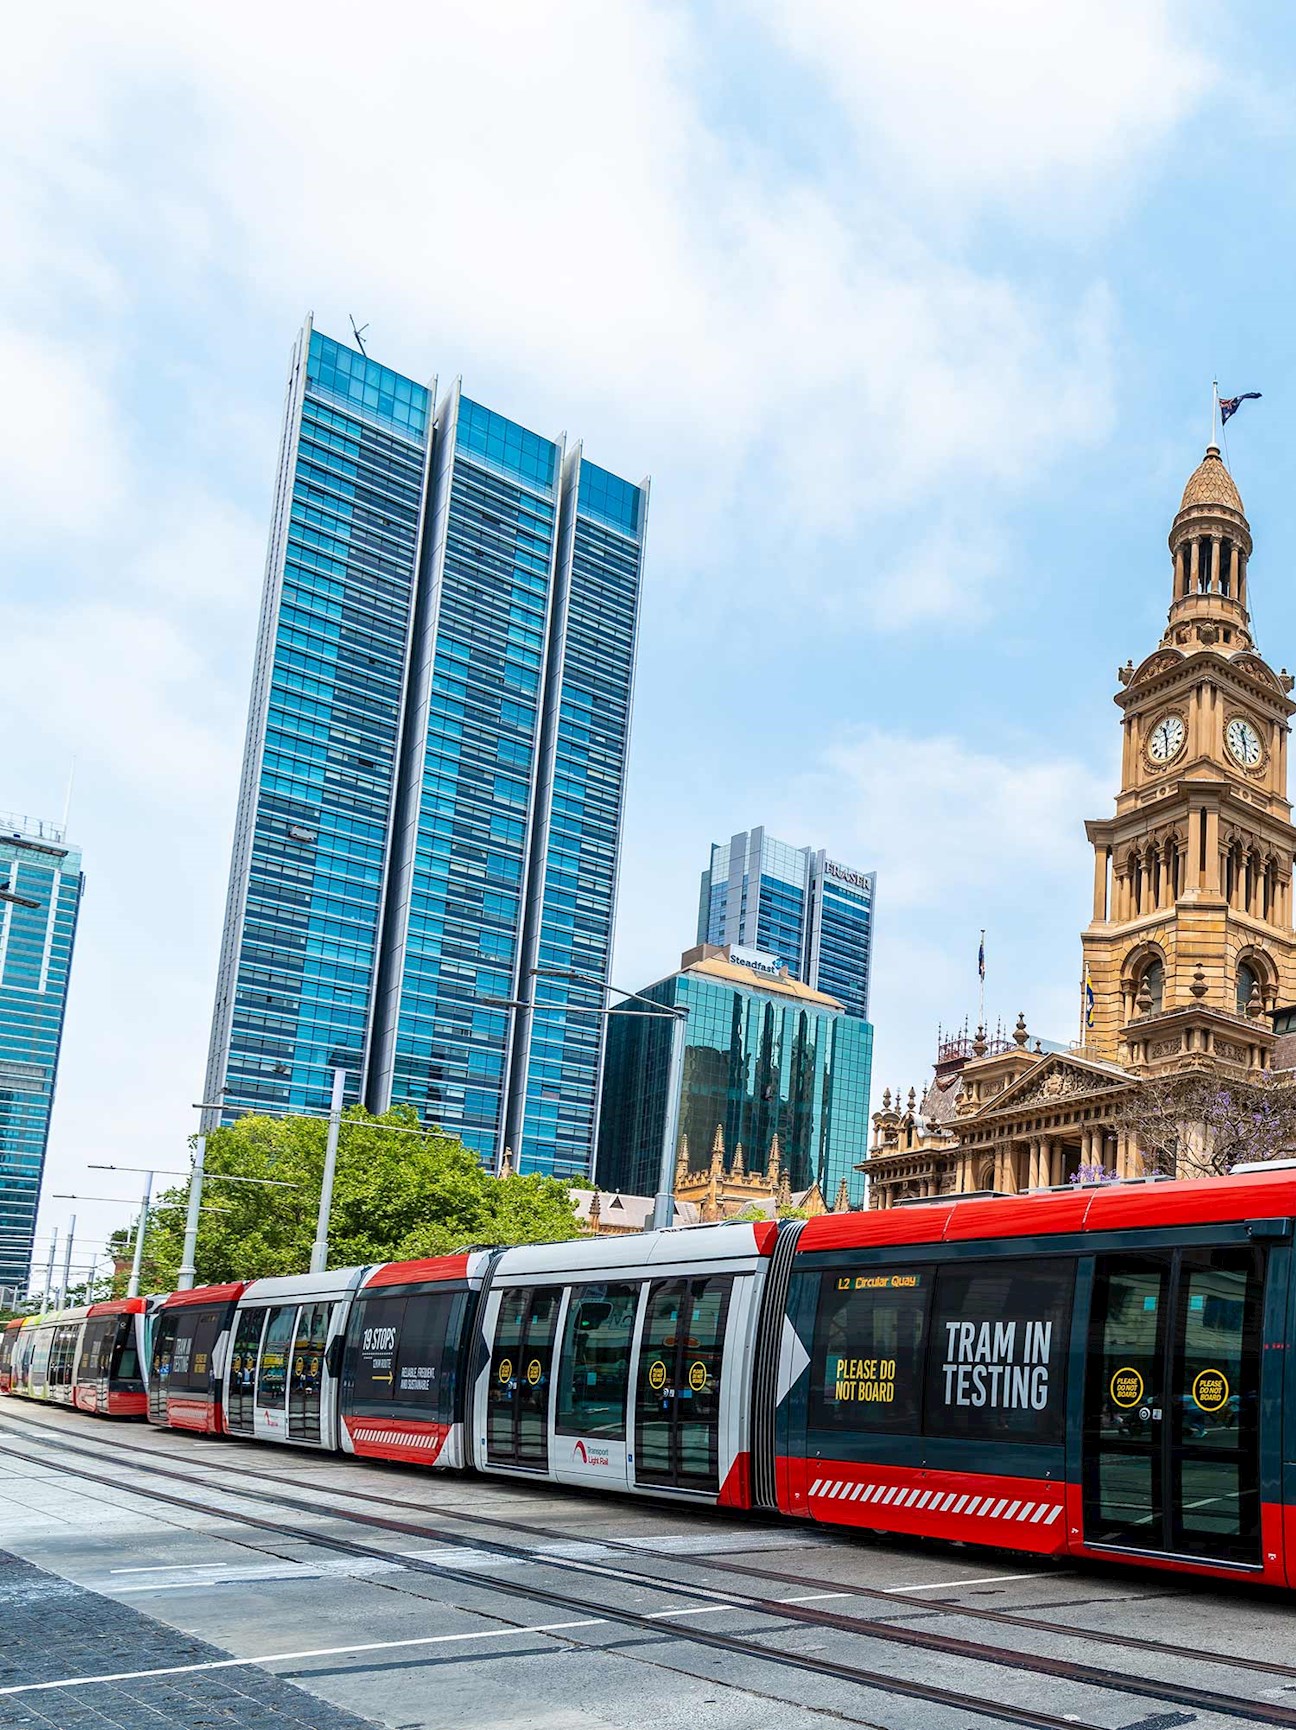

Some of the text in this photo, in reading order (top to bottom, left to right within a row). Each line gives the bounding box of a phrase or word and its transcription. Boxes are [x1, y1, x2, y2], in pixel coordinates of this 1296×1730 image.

[825, 861, 871, 891] FRASER
[730, 954, 775, 974] Steadfast
[838, 1275, 916, 1290] L2 Circular Quay
[363, 1327, 396, 1350] 19 STOPS
[945, 1321, 1052, 1364] TRAM IN
[837, 1359, 896, 1380] PLEASE DO
[835, 1381, 895, 1402] NOT BOARD
[942, 1364, 1048, 1410] TESTING
[1200, 1393, 1221, 1402] BOARD
[588, 1456, 599, 1466] Light
